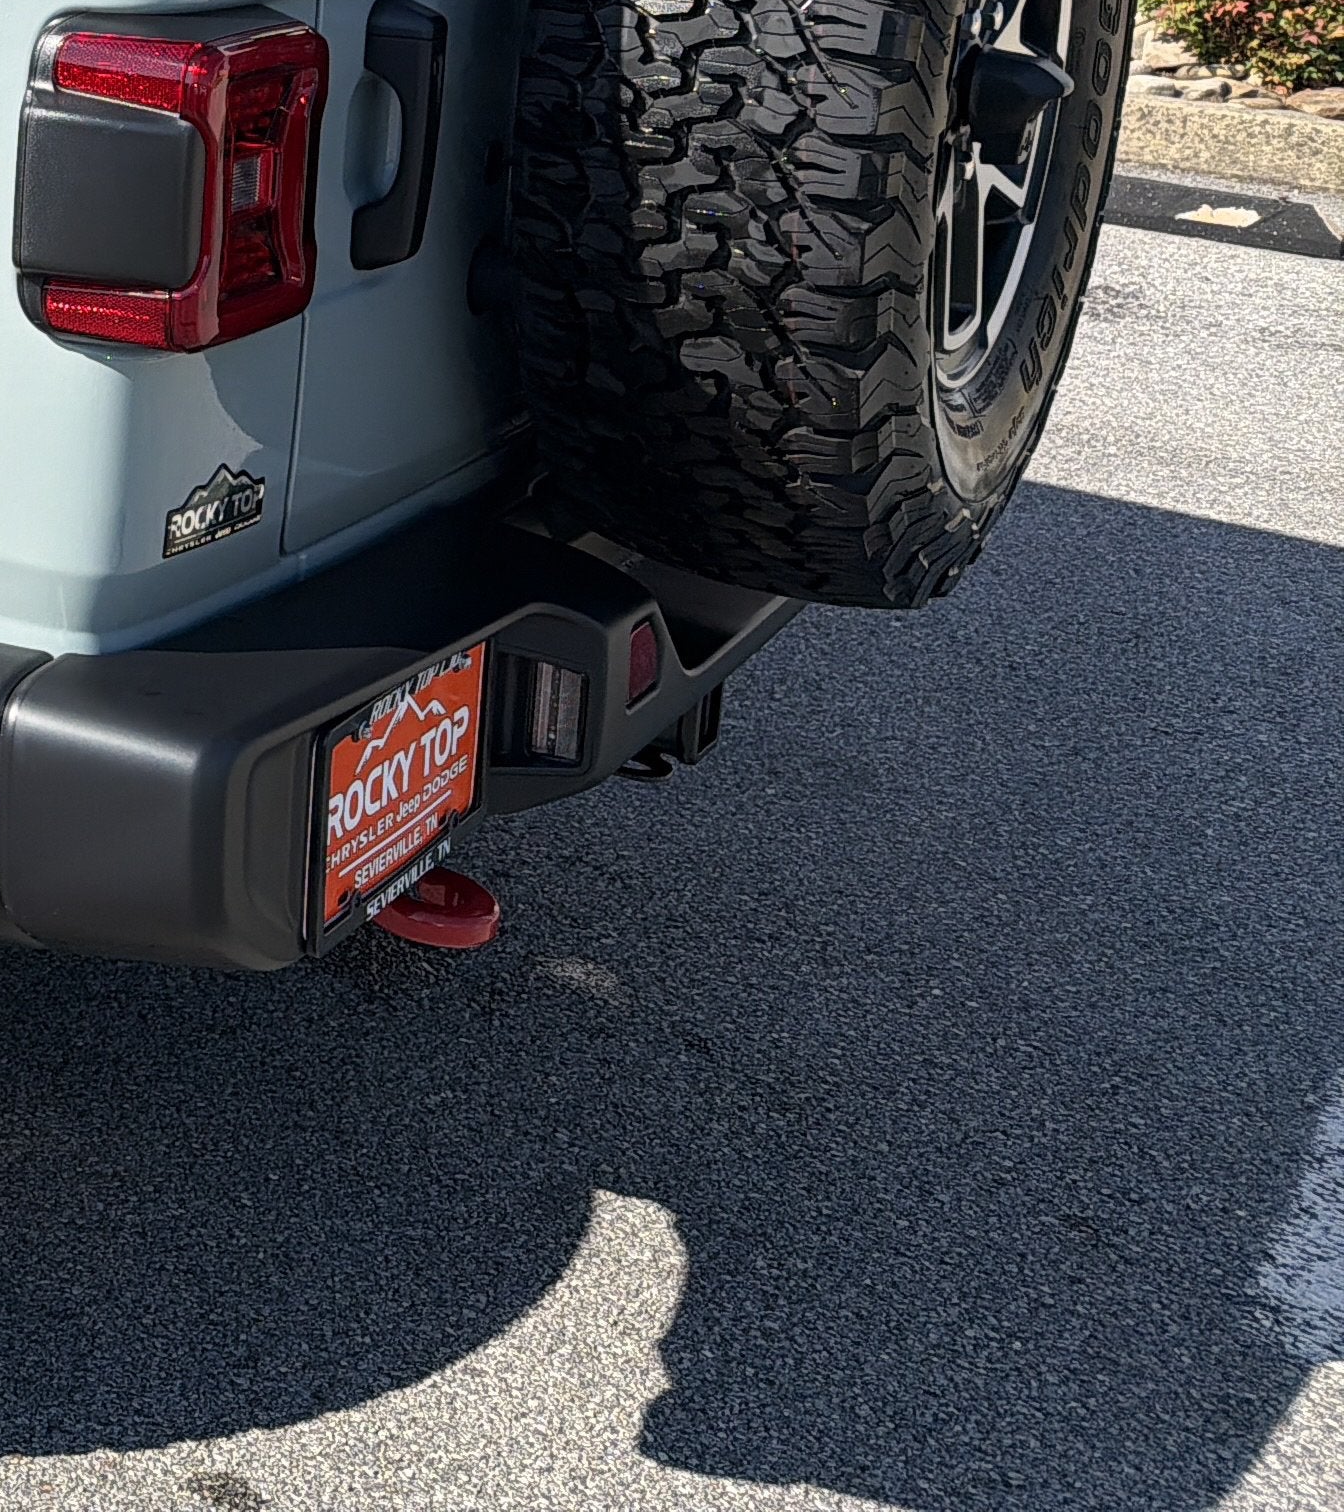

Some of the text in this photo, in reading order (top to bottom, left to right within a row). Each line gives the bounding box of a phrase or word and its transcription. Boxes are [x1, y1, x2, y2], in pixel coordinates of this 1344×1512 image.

[168, 499, 228, 539] ROCKY
[232, 484, 264, 517] TOP
[326, 705, 470, 846] ROCKY TOP
[397, 794, 421, 822] Jeep
[423, 754, 469, 802] DODGE
[425, 812, 439, 833] TN
[438, 837, 452, 862] TN
